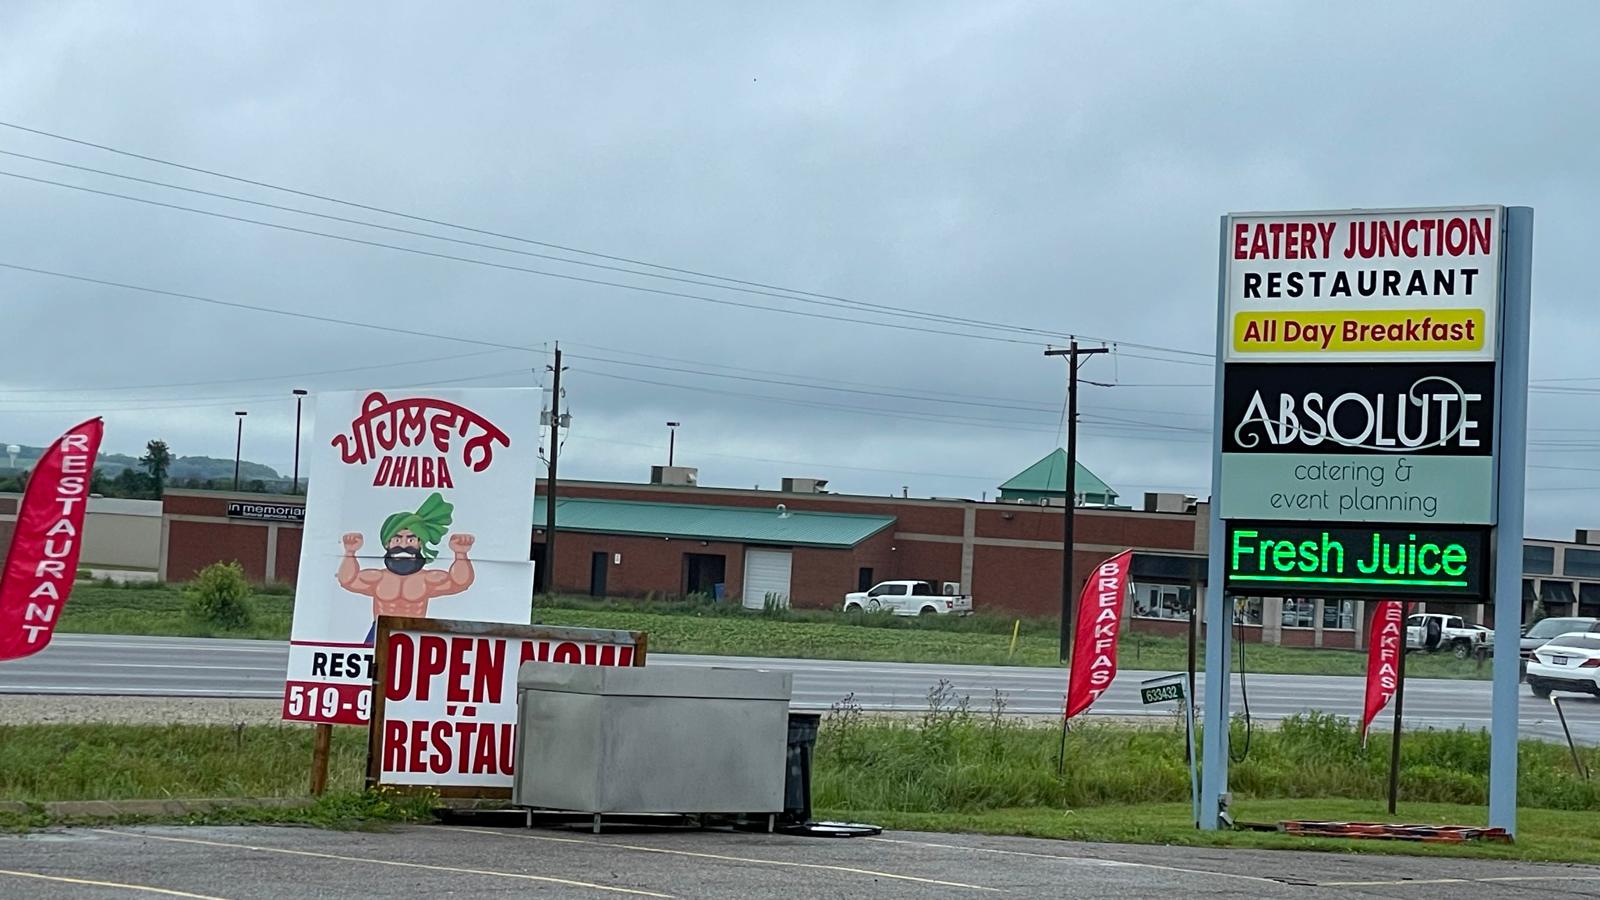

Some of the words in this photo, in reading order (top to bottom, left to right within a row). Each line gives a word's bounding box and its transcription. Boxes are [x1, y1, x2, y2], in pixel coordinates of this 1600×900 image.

[1234, 222, 1336, 260] EATERY
[1344, 217, 1491, 258] JUNCTION
[1244, 268, 1479, 298] RESTAURANT
[1243, 319, 1276, 342] All
[1284, 320, 1336, 349] Day
[1342, 317, 1475, 342] Breakfast
[1235, 379, 1482, 450] ABSOLUTE
[372, 455, 454, 488] DHABA
[1294, 460, 1385, 487] catering
[1395, 457, 1414, 482] &
[242, 505, 306, 516] memoria
[1270, 490, 1329, 509] event
[1339, 487, 1438, 517] planning
[22, 434, 90, 644] RESTAURANT
[1232, 530, 1344, 573] Fresh
[1357, 533, 1468, 576] Juice
[1089, 562, 1120, 700] BREAKFAST
[386, 633, 505, 704] OPEN
[1146, 685, 1178, 702] 633432
